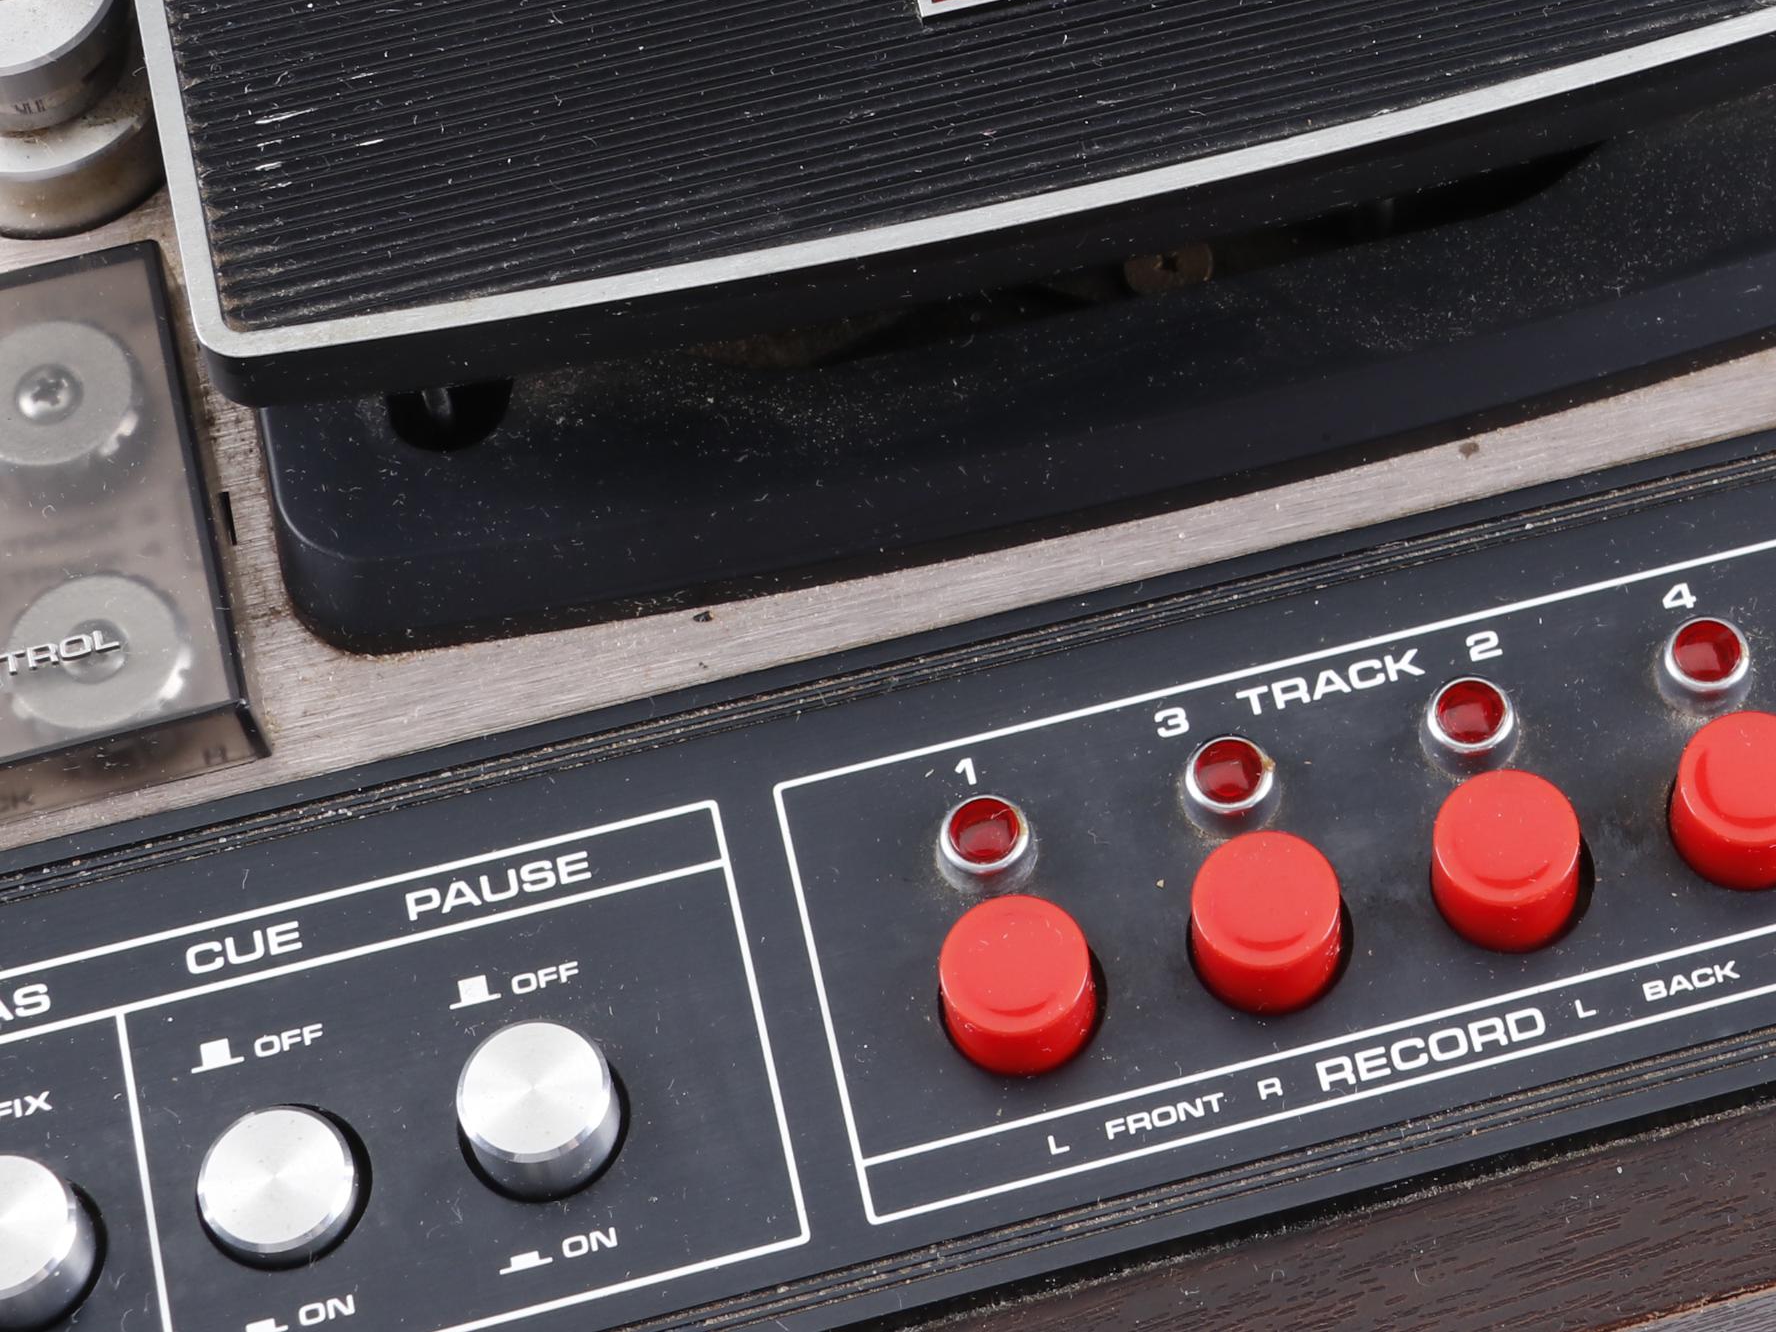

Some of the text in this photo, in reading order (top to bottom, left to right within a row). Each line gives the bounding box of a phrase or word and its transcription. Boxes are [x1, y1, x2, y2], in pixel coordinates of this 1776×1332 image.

[954, 582, 1697, 786] 1 3 TRACK 2 4
[185, 920, 303, 975] CUE
[405, 850, 592, 922] PAUSE
[511, 960, 579, 995] OFF
[253, 1023, 323, 1058] OFF
[1047, 1135, 1071, 1156] L
[1104, 1091, 1224, 1141] FRONT
[1256, 1076, 1284, 1101] R
[1315, 1007, 1546, 1092] RECORD
[1574, 999, 1597, 1019] L
[1642, 960, 1741, 1002] BACK
[561, 1226, 618, 1259] ON
[298, 1294, 356, 1327] ON
